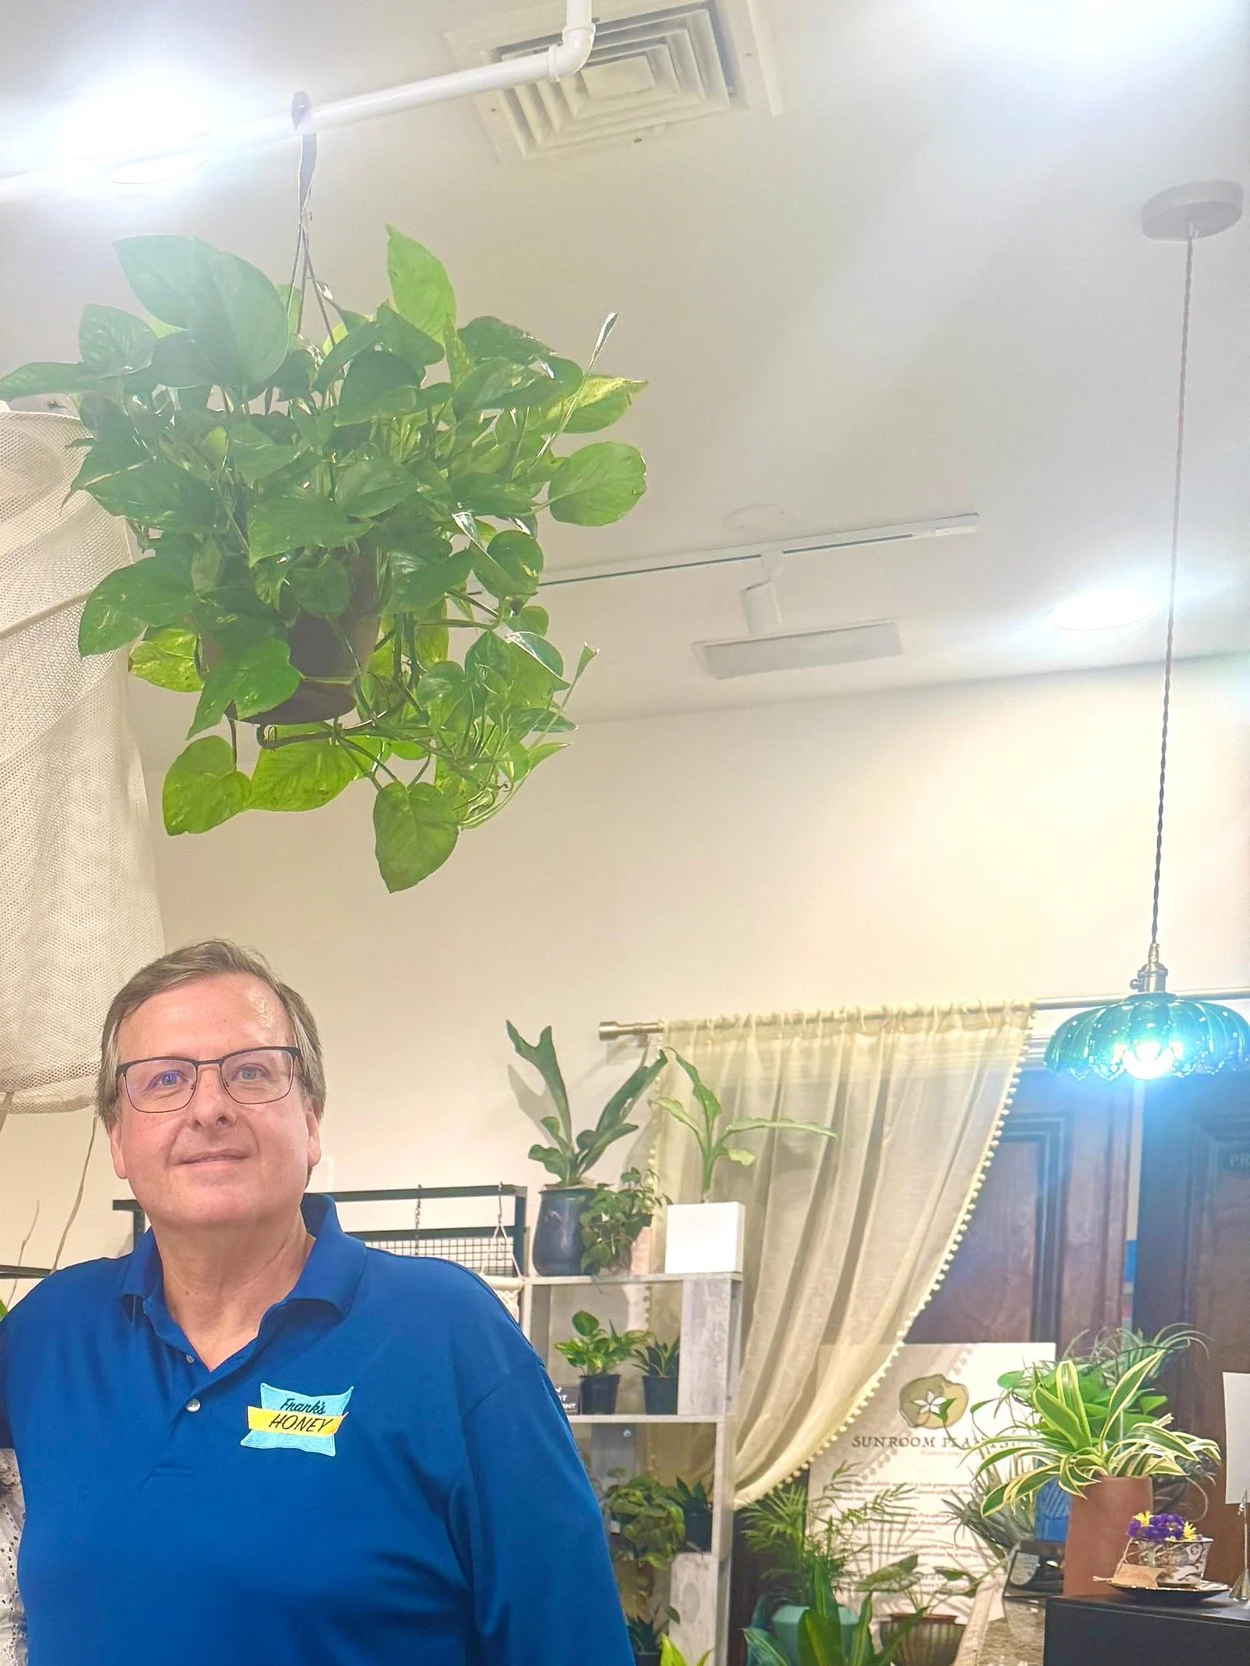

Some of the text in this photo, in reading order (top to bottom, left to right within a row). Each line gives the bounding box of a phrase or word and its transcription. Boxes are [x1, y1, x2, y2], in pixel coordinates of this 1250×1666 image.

[279, 1398, 327, 1415] Frank's
[268, 1413, 334, 1433] HONEY
[851, 1436, 936, 1449] SUNROOM
